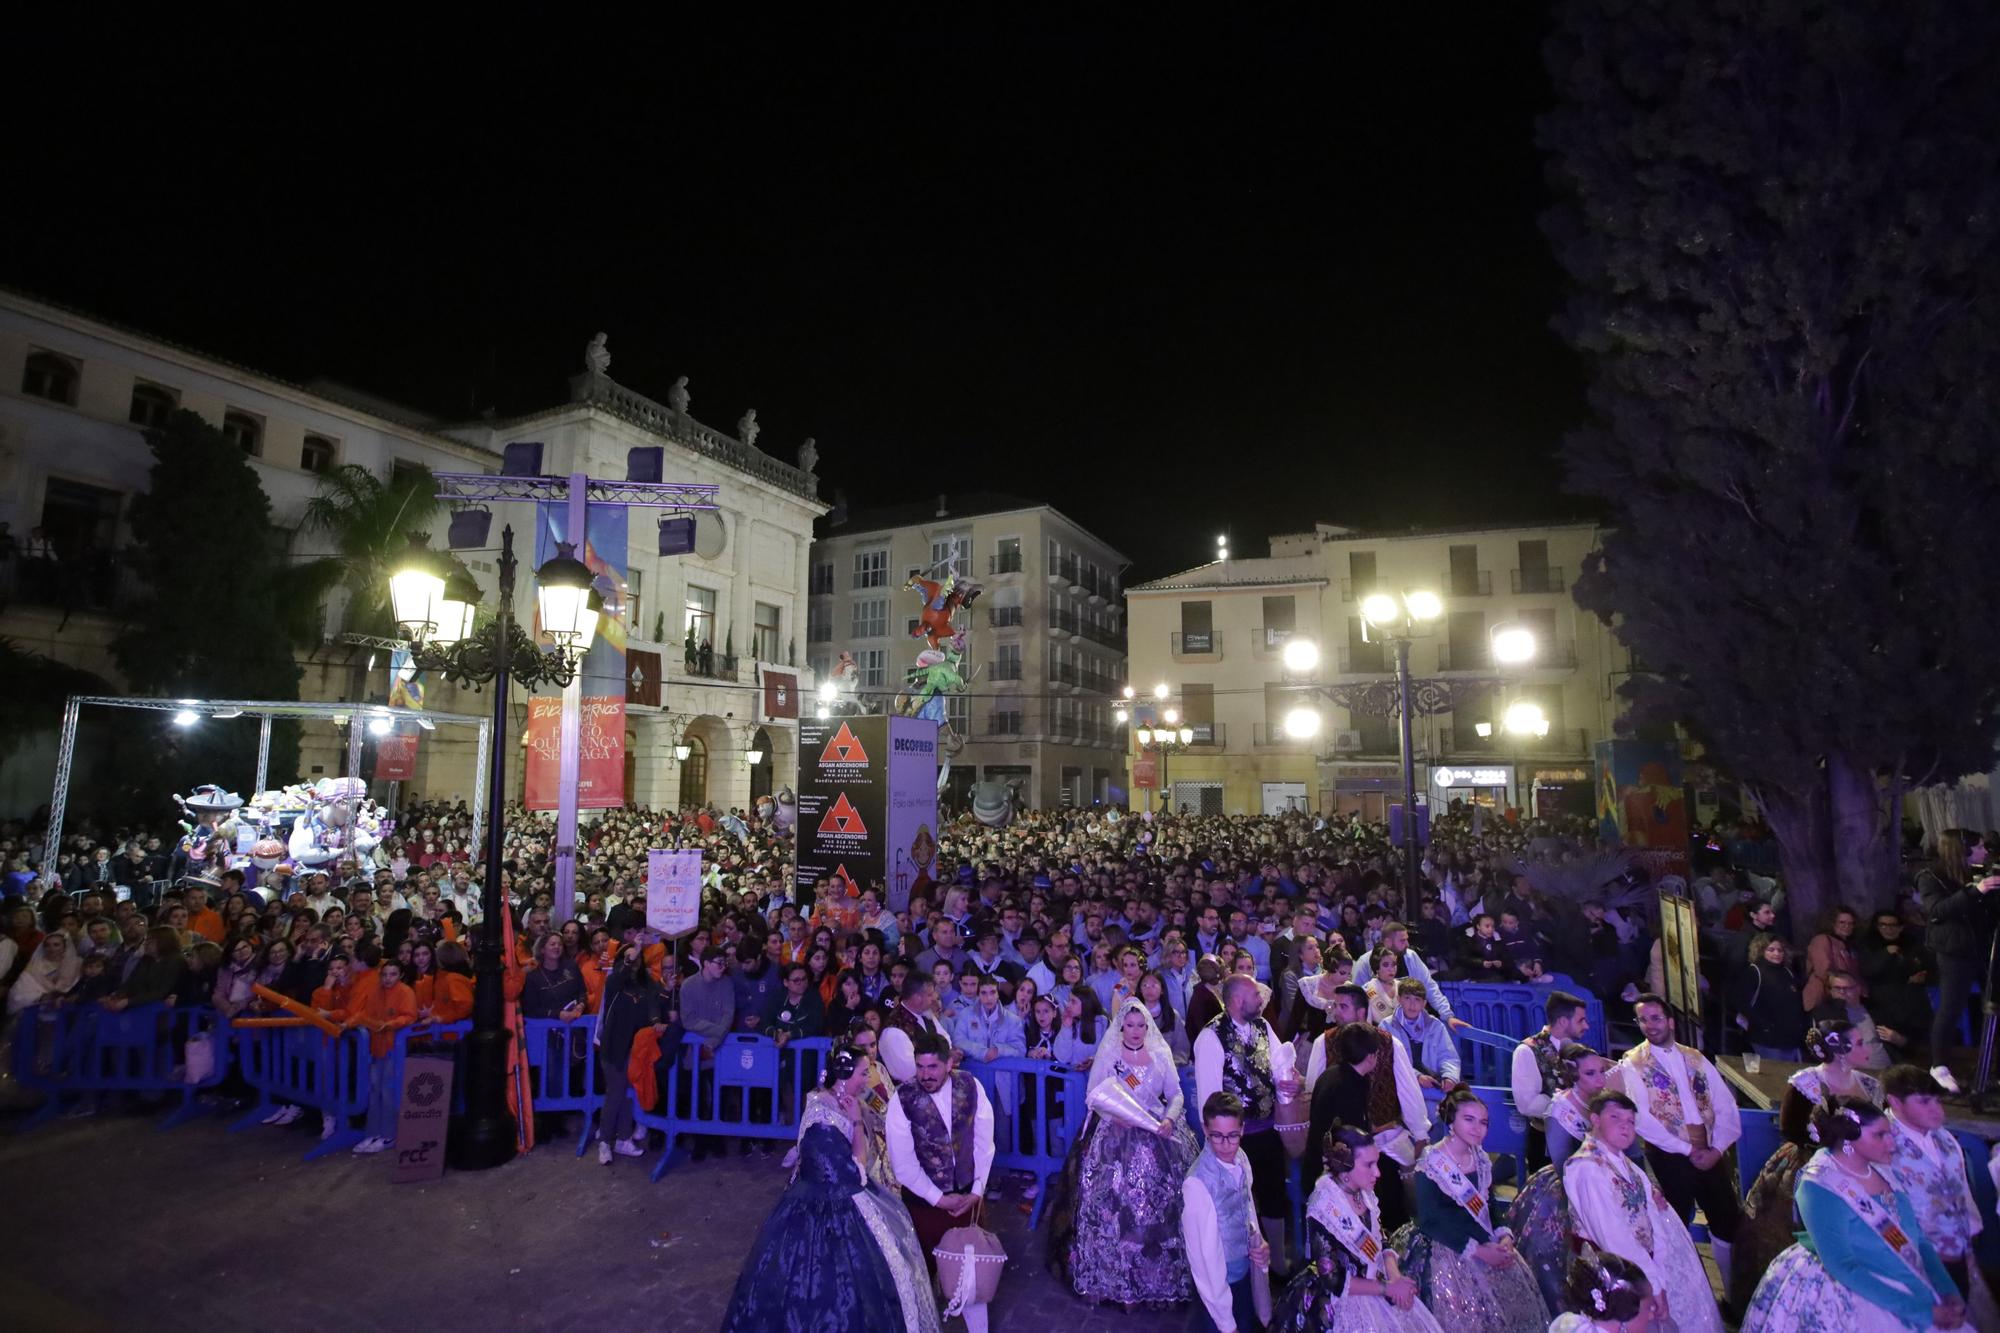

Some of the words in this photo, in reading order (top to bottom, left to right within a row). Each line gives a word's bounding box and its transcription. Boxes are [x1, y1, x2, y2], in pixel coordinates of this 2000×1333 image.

[552, 726, 602, 738] FGO
[576, 736, 619, 748] UNCA
[894, 738, 934, 752] DECOFRED
[404, 1109, 442, 1120] Gandia
